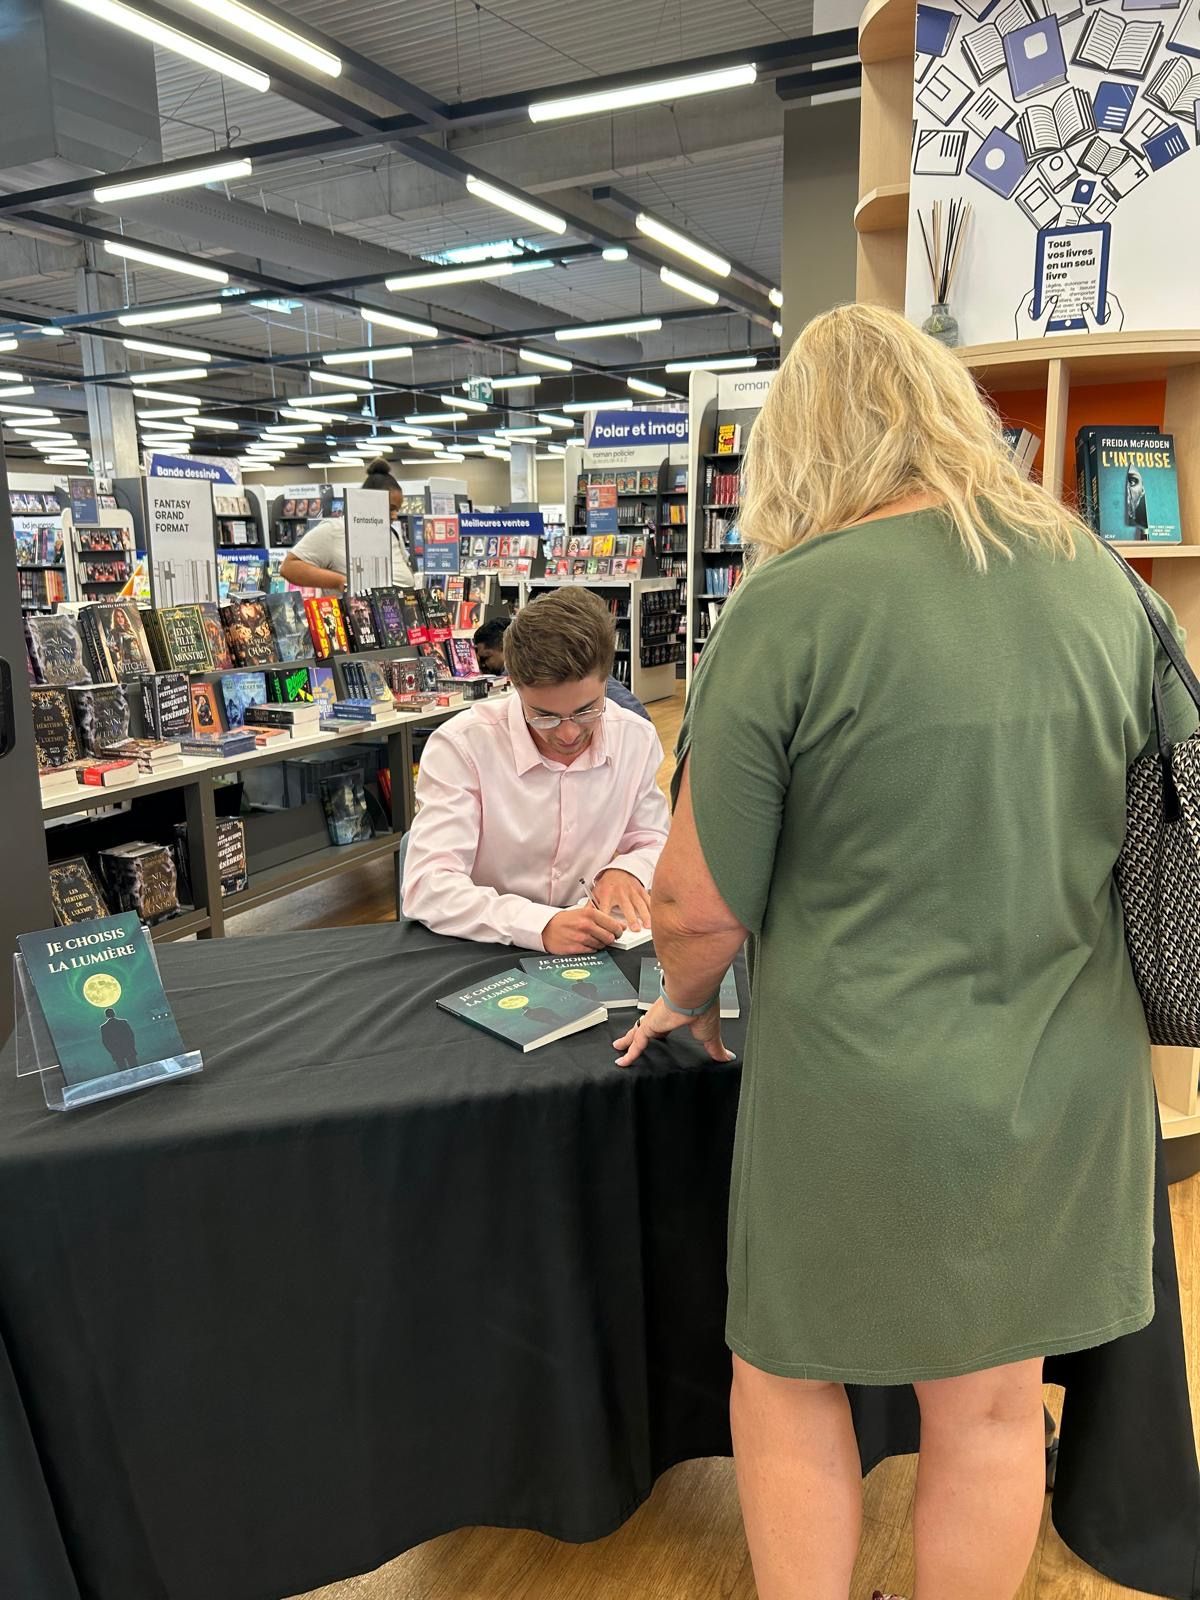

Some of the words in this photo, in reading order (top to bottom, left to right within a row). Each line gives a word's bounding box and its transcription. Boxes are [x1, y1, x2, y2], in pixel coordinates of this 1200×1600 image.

[1048, 240, 1071, 248] Tous
[1066, 248, 1093, 257] livres
[1075, 257, 1095, 268] seul
[1046, 271, 1067, 280] livre
[734, 381, 770, 391] roman
[595, 424, 630, 438] Polar
[632, 422, 646, 435] et
[648, 418, 689, 437] imagi
[1101, 438, 1128, 448] FREIDA
[1130, 440, 1170, 449] McFADDEN
[613, 449, 635, 458] policier
[1102, 451, 1171, 468] L'INTRUSE
[157, 465, 184, 477] Bande
[185, 468, 220, 479] dessinée
[154, 499, 191, 509] FANTASY
[155, 511, 184, 520] GRAND
[353, 516, 383, 526] Fantastique
[461, 519, 501, 528] Meilleures
[502, 519, 530, 528] ventes
[155, 523, 189, 532] FORMAT
[174, 651, 206, 662] MONSTRE
[161, 706, 189, 722] TÉNÈBRES
[46, 942, 64, 957] JE
[65, 928, 126, 949] CHOISIS
[48, 960, 70, 974] LA
[71, 943, 136, 969] LUMIÈRE
[552, 956, 597, 965] CHOISIS
[555, 960, 604, 969] LUMIÈRE
[458, 993, 473, 1003] JE
[472, 976, 515, 997] CHOISIS
[465, 999, 482, 1008] LA
[482, 980, 528, 1001] LUMIÈRE
